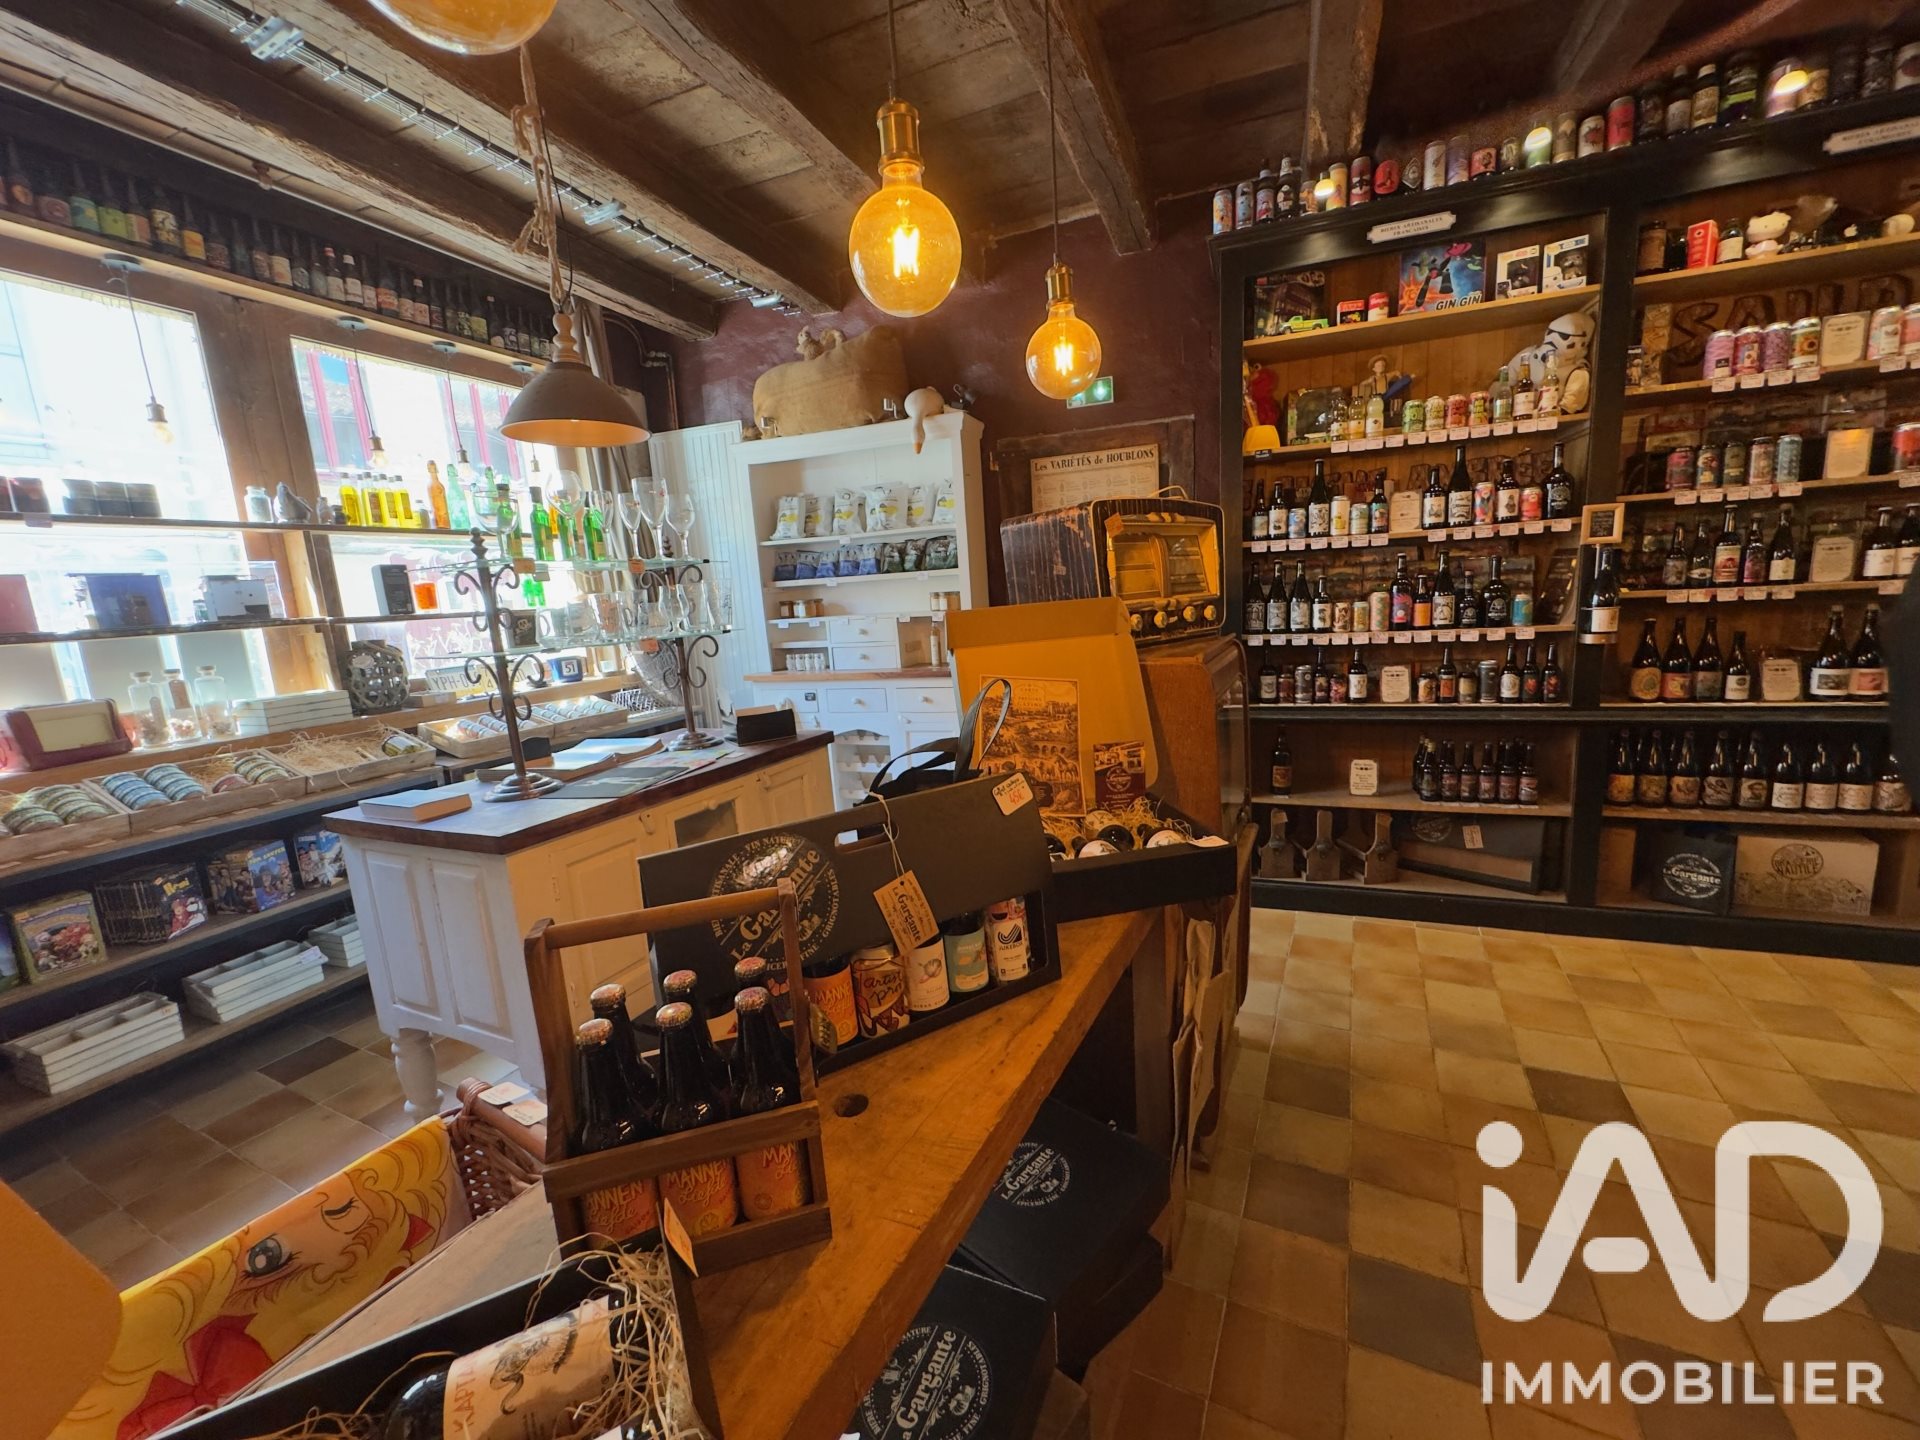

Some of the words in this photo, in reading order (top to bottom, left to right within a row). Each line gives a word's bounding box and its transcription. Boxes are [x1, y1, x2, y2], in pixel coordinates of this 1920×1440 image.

[1435, 299, 1457, 311] GIN
[1459, 294, 1483, 307] GIN
[1034, 462, 1048, 472] Les
[1051, 453, 1092, 470] VARIÉTÉS
[1094, 455, 1104, 465] de
[1106, 447, 1155, 464] HOUBLONS
[564, 663, 576, 675] 51
[744, 839, 761, 851] VIN
[1671, 864, 1722, 885] Gargante
[821, 867, 840, 938] GRIGNOTABLES
[897, 893, 922, 942] Gargante
[730, 941, 753, 961] La
[800, 943, 820, 962] FINE
[1005, 1147, 1055, 1190] Gargante
[895, 1330, 957, 1430] Gargante
[966, 1340, 990, 1405] GRIGNOTABLES
[962, 1412, 982, 1435] FINE
